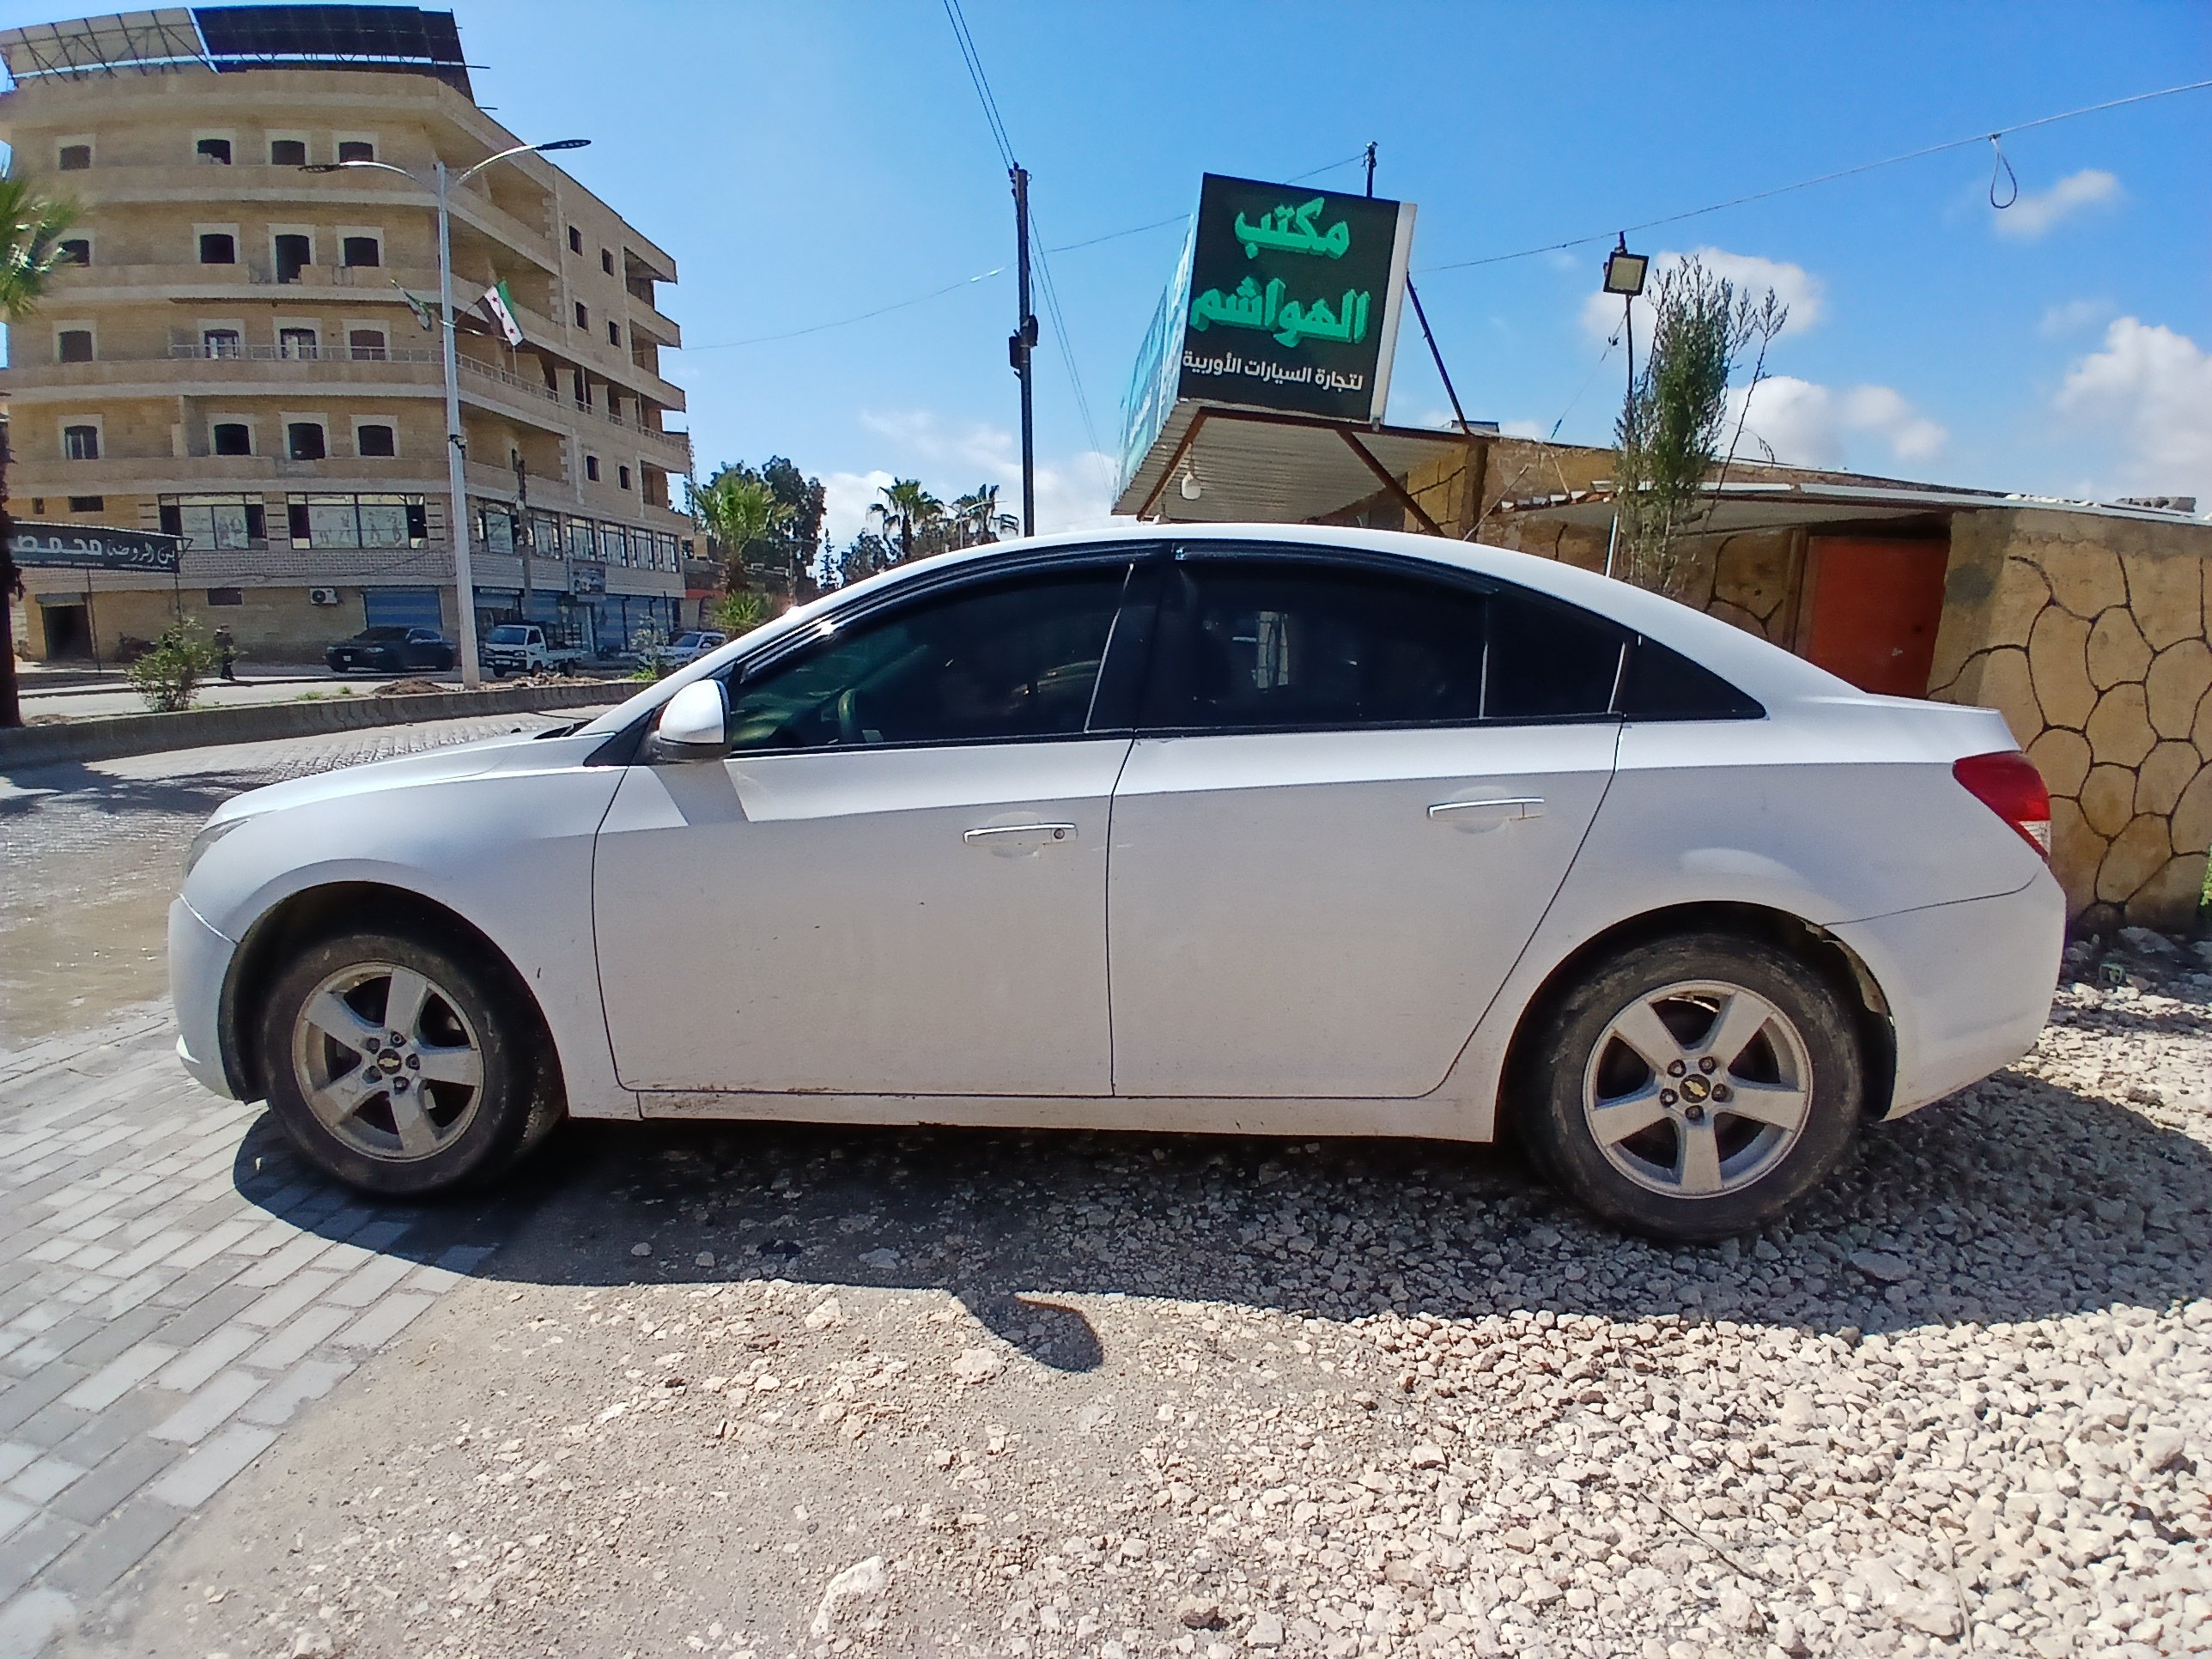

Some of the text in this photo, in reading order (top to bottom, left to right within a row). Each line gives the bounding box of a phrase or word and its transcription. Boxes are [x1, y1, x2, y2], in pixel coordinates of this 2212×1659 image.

[1235, 197, 1350, 259] مكتب
[1190, 276, 1371, 348] الهواشم
[1182, 349, 1364, 393] لتجارة السيارات الأوربية
[12, 535, 102, 556] محمص
